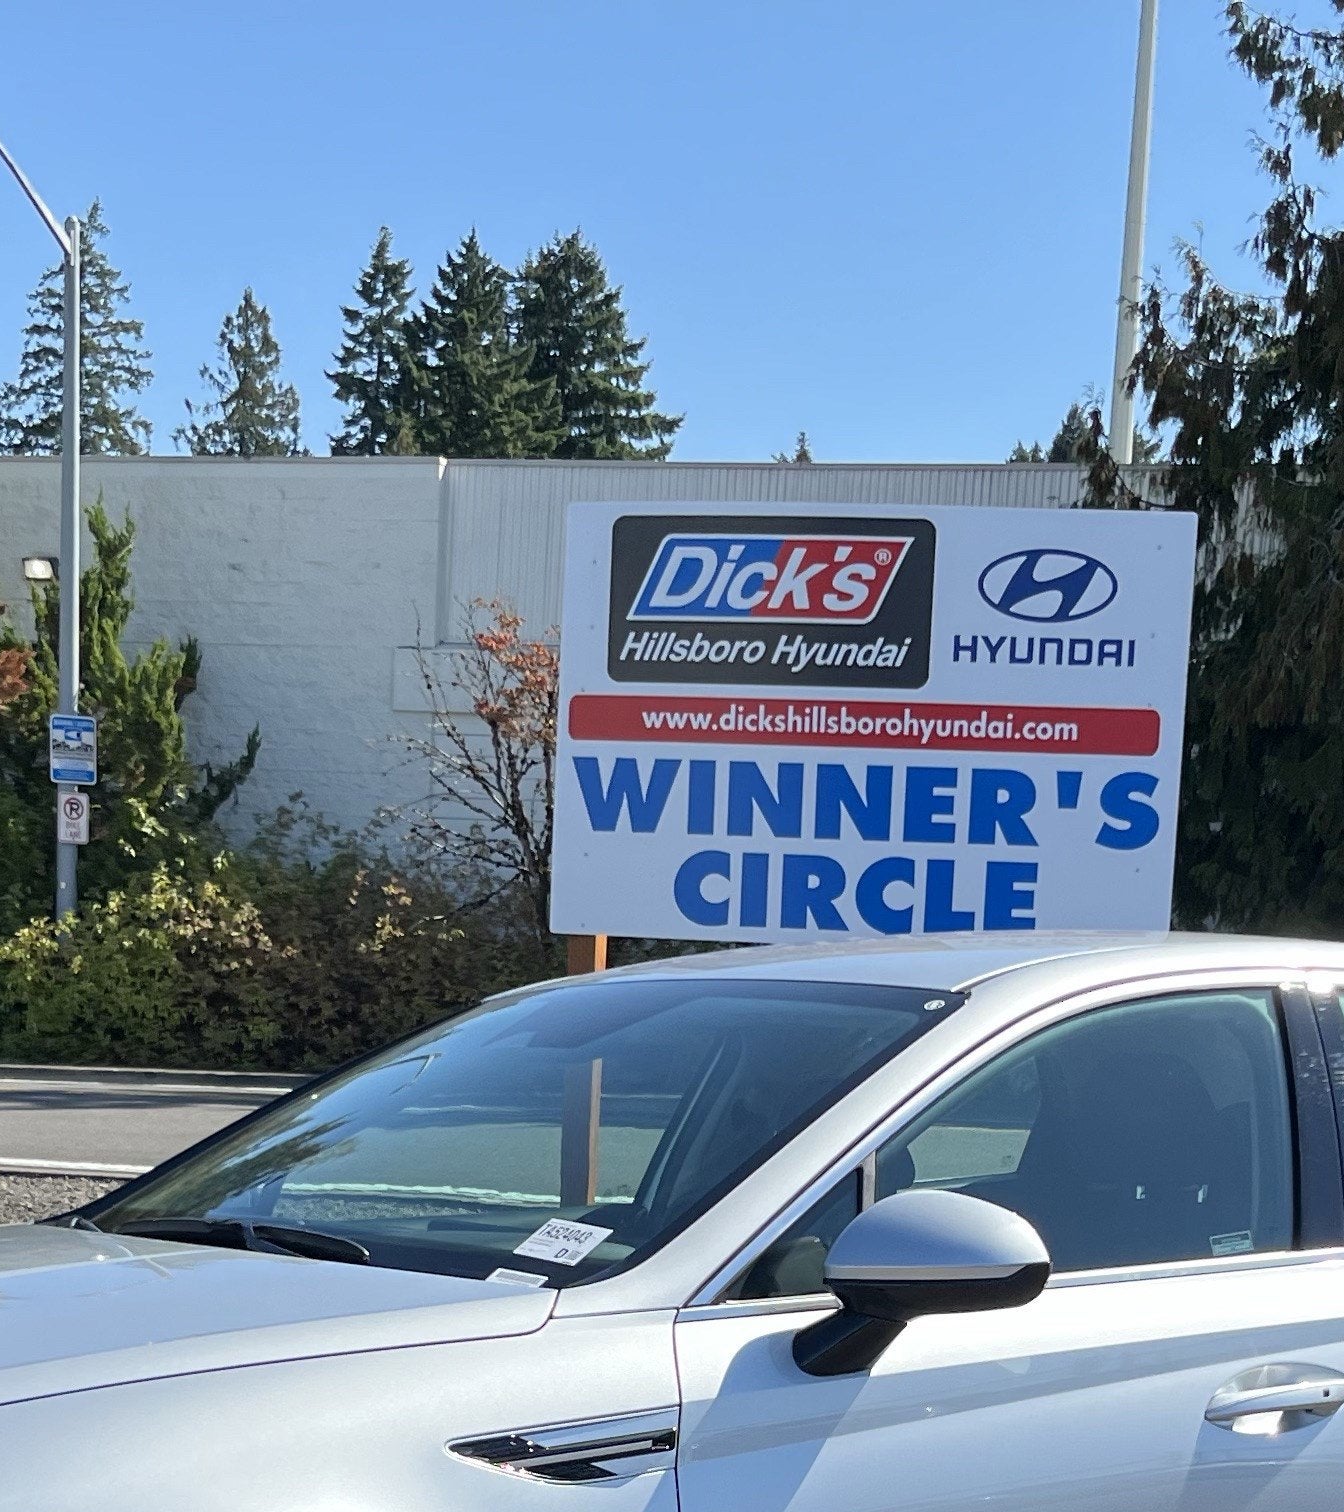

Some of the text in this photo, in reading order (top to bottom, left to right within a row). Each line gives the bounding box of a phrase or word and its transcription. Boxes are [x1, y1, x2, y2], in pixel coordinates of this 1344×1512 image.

[649, 545, 876, 612] Dick's
[619, 631, 912, 673] Hillsboro Hyundai
[953, 634, 1136, 668] HYUNDAI
[642, 704, 1078, 744] www.dickshillsborohyundai.com
[572, 757, 1160, 850] WINNER'S
[673, 850, 1040, 935] CIRCLE
